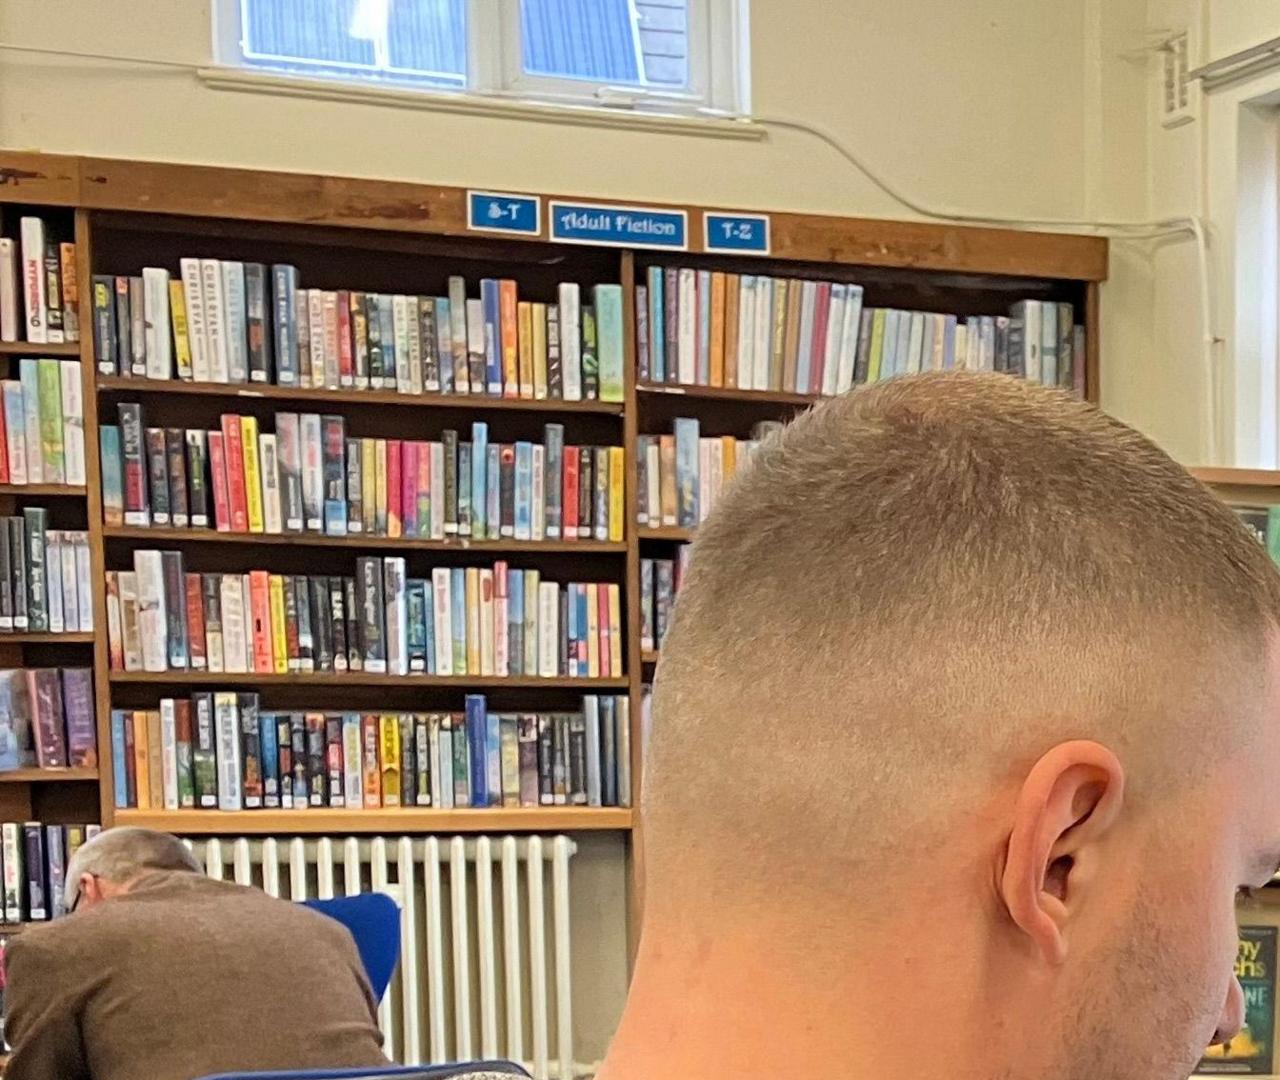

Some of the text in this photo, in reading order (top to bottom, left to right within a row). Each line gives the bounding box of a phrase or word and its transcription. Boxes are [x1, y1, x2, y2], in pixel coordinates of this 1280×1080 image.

[561, 212, 676, 236] Adult Fiction
[721, 222, 753, 240] T-Z
[187, 263, 203, 335] CHRIS RYAN
[204, 263, 219, 336] CHRIS RYAN
